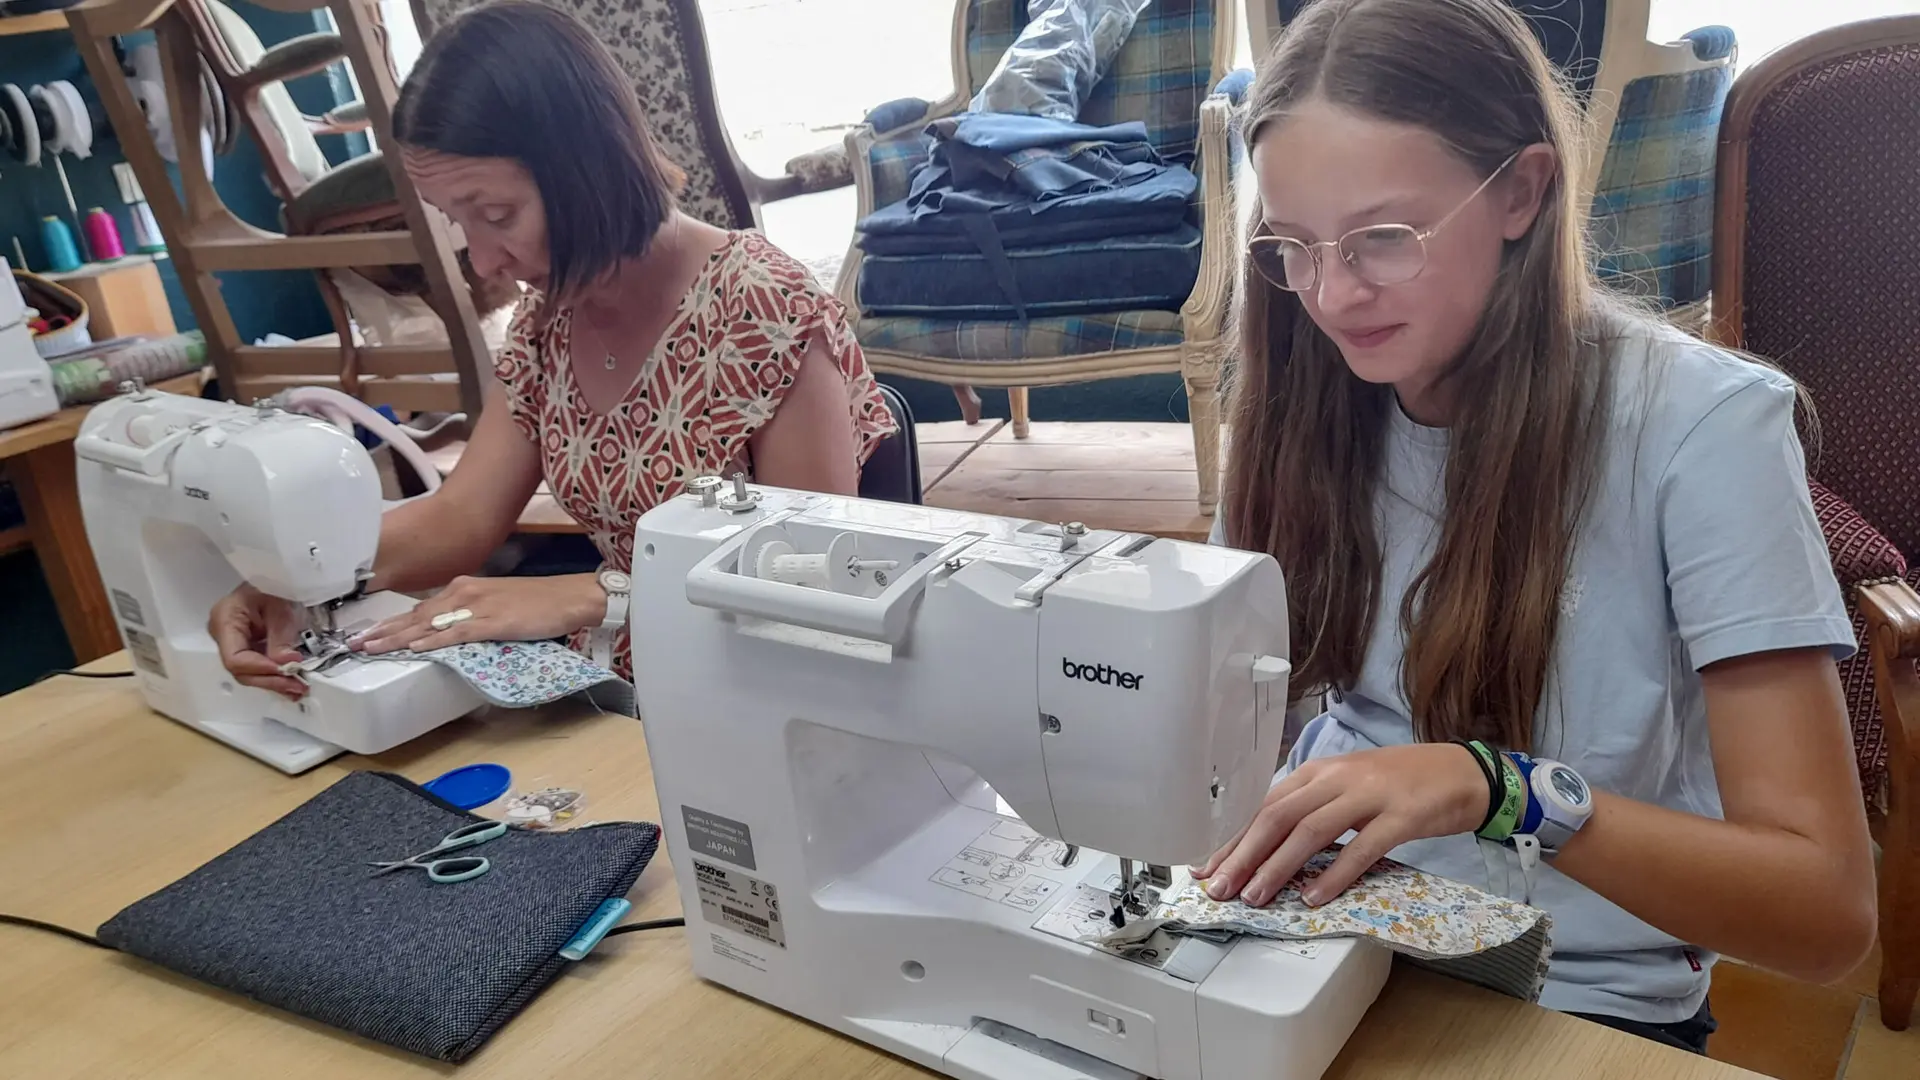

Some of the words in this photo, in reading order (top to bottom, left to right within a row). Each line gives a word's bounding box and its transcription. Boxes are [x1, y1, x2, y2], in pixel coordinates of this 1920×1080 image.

[1062, 656, 1144, 690] brother
[706, 840, 736, 857] JAPAN
[695, 861, 726, 879] brother
